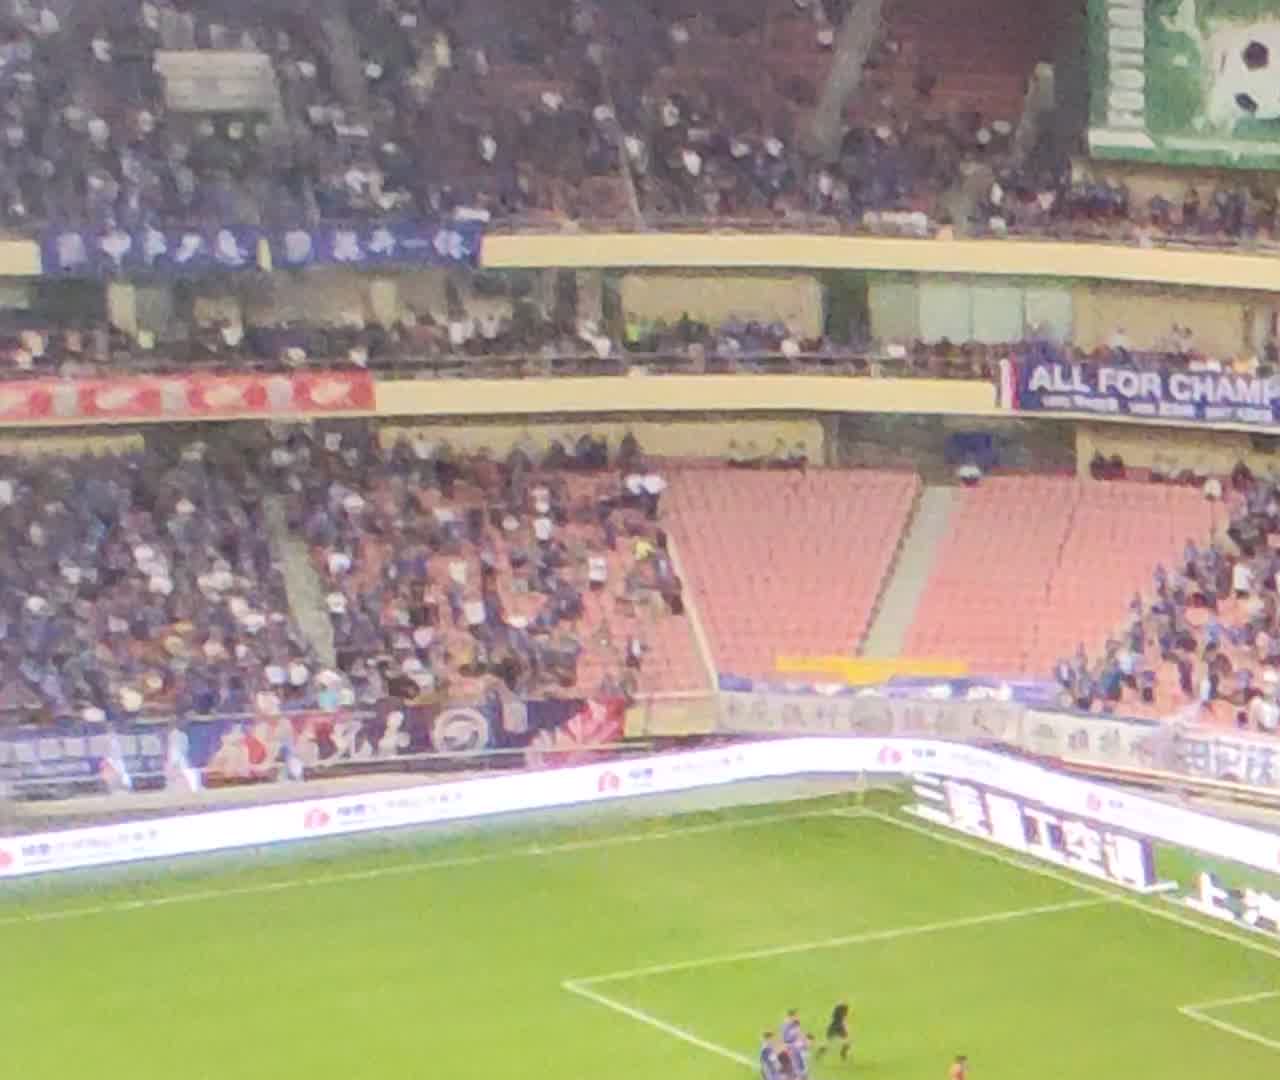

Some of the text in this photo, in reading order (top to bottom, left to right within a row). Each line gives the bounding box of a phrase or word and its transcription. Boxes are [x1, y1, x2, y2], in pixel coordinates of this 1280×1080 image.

[1105, 0, 1146, 128] FOOTBA
[1027, 365, 1092, 394] ALL
[1097, 367, 1162, 399] FOR
